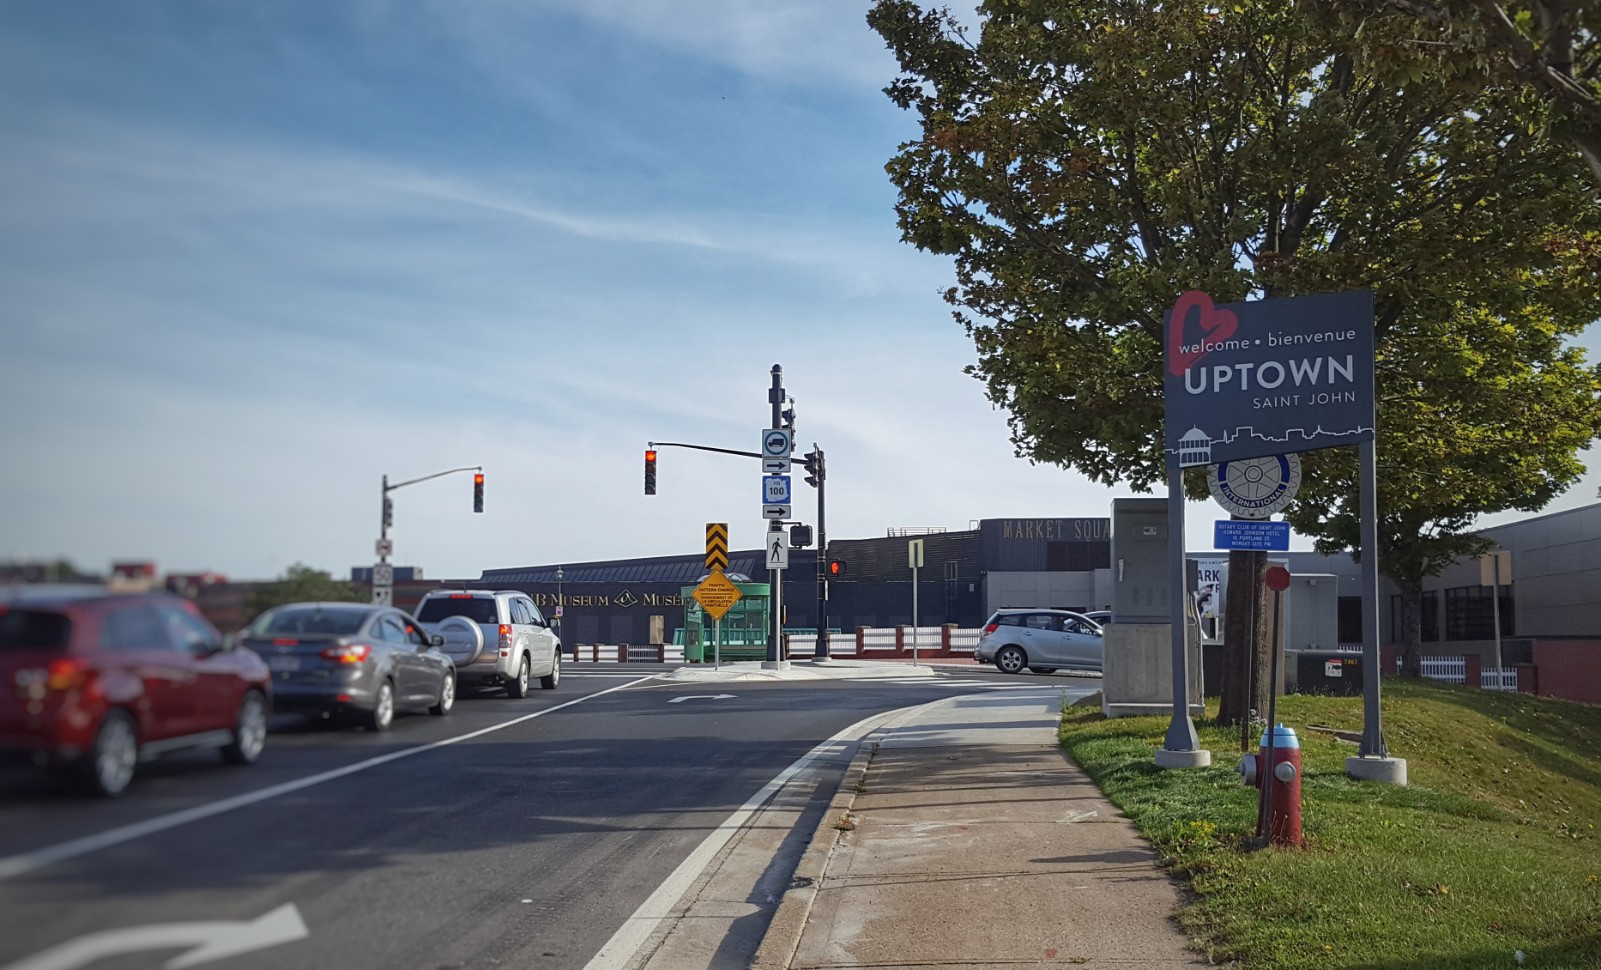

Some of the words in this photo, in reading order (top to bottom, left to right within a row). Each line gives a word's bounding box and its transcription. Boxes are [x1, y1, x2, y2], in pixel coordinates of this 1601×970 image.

[1178, 337, 1250, 355] welcome
[1268, 328, 1356, 347] bienvenue
[1184, 354, 1353, 395] UPTOWN
[1253, 395, 1300, 409] SAINT
[1308, 391, 1356, 405] JOHN
[769, 487, 784, 496] 100
[1222, 486, 1285, 507] INTERNATIONAL
[1003, 519, 1062, 539] MARKET
[1074, 519, 1110, 541] SQUA
